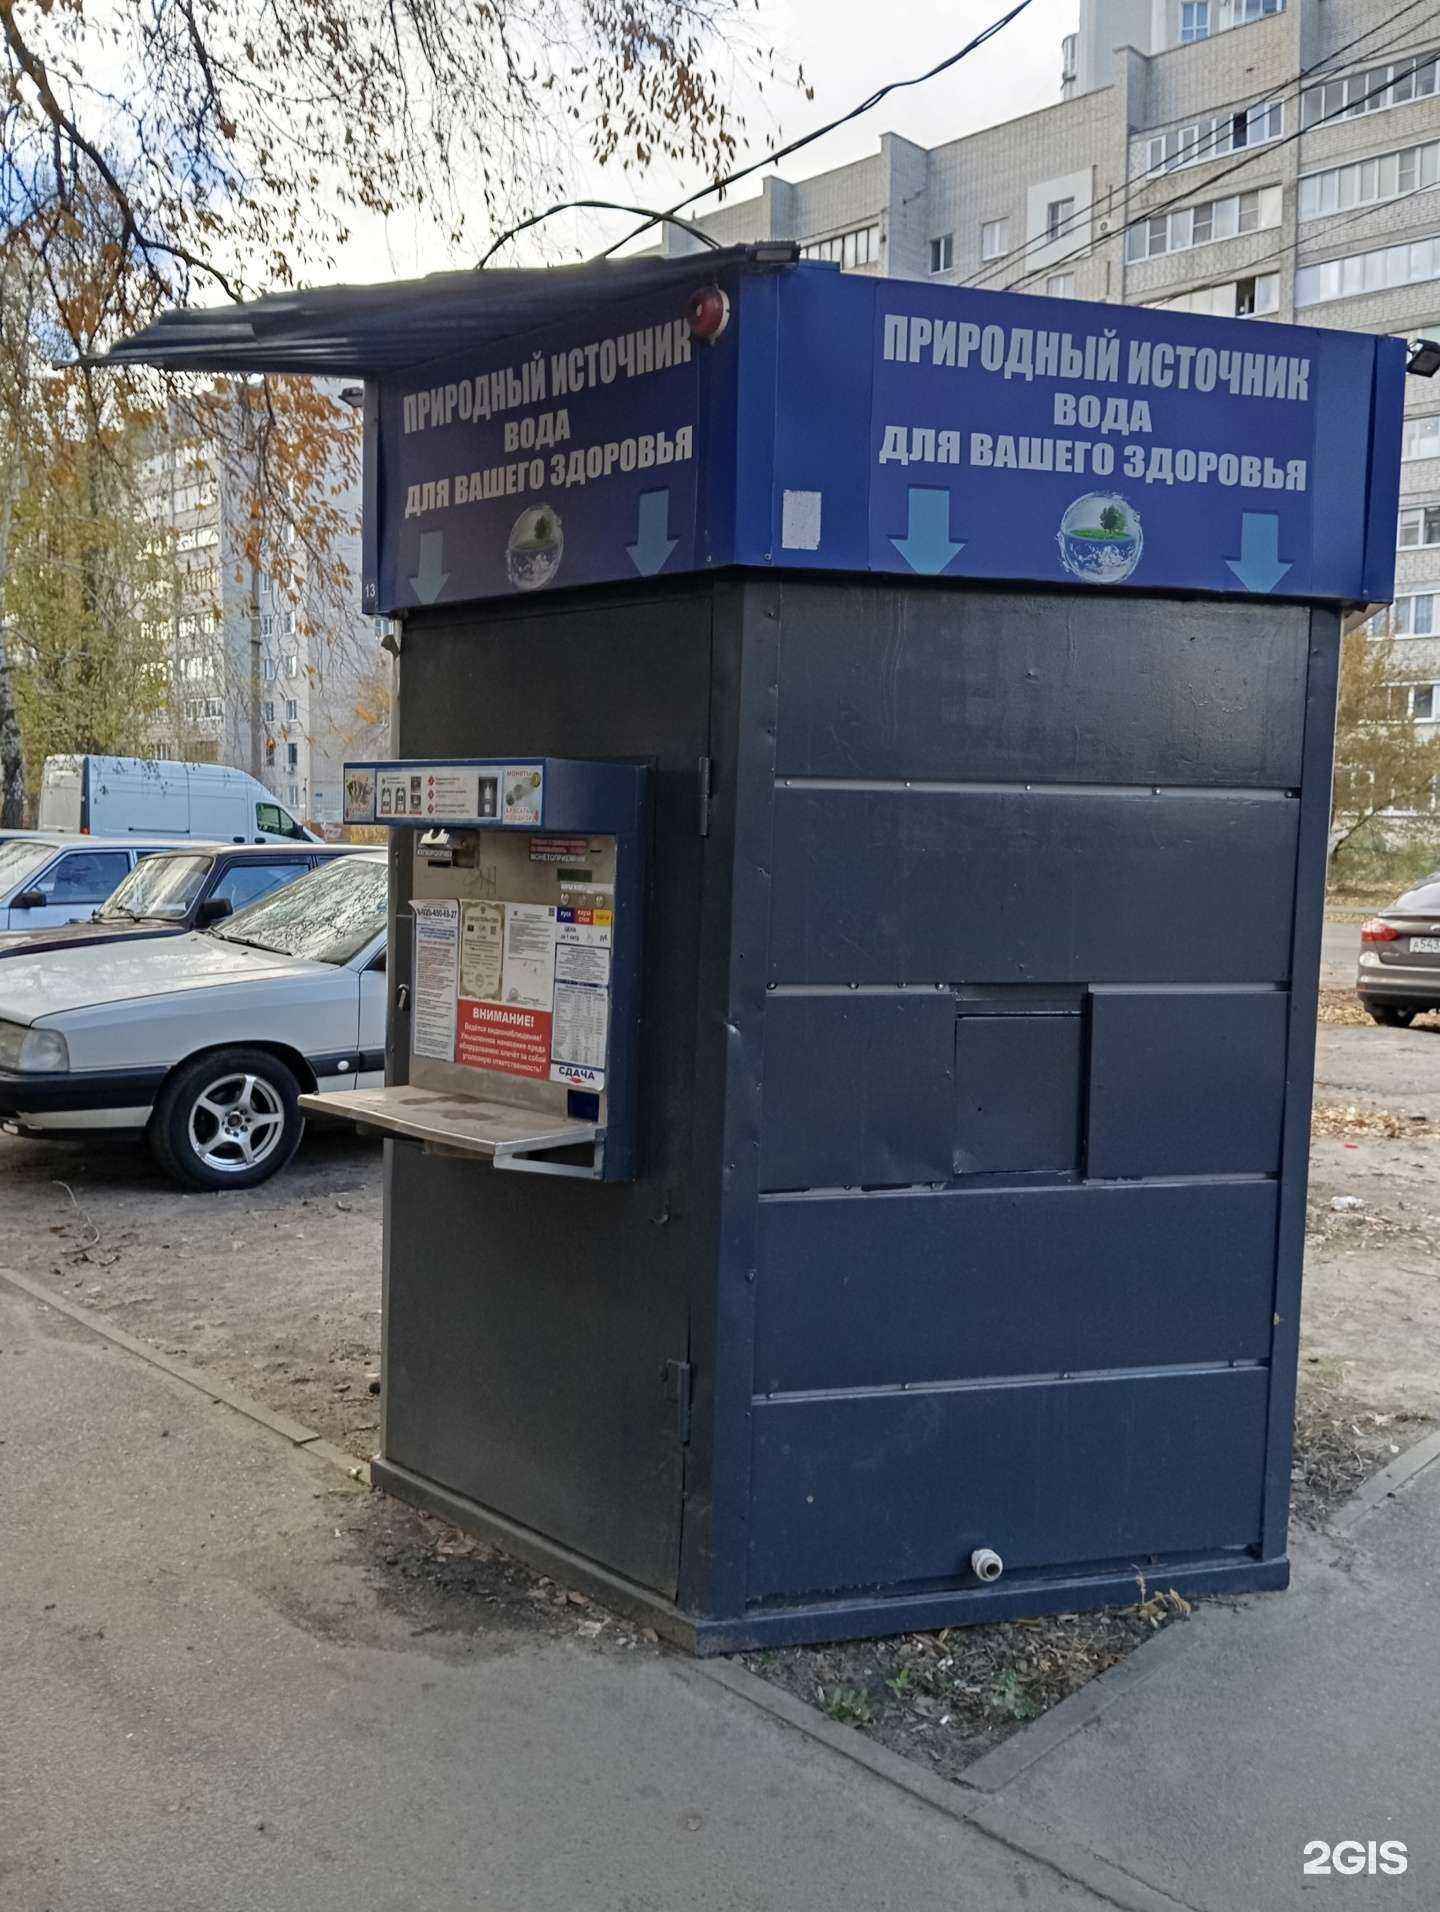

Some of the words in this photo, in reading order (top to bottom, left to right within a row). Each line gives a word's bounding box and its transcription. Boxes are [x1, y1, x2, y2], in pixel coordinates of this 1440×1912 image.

[403, 352, 546, 434] ПРИРОДНЫЙ
[551, 318, 692, 397] ИСТОЧНИК
[883, 314, 1119, 383] ПРИРОДНЫЙ
[1127, 341, 1310, 401] ИСТОЧНИК
[504, 408, 570, 452] ВОДА
[1054, 392, 1152, 433] ВОДА
[405, 478, 449, 519] ДЛЯ
[455, 457, 544, 505] ВАШЕГО
[550, 425, 694, 488] ЗДОРОВЬЯ
[879, 426, 960, 466] ДЛЯ
[970, 432, 1115, 476] ВАШЕГО
[1123, 443, 1307, 492] ЗДОРОВЬЯ
[473, 1007, 535, 1028] ВНИМАНИЕ!
[558, 1066, 595, 1080] СДАЧА
